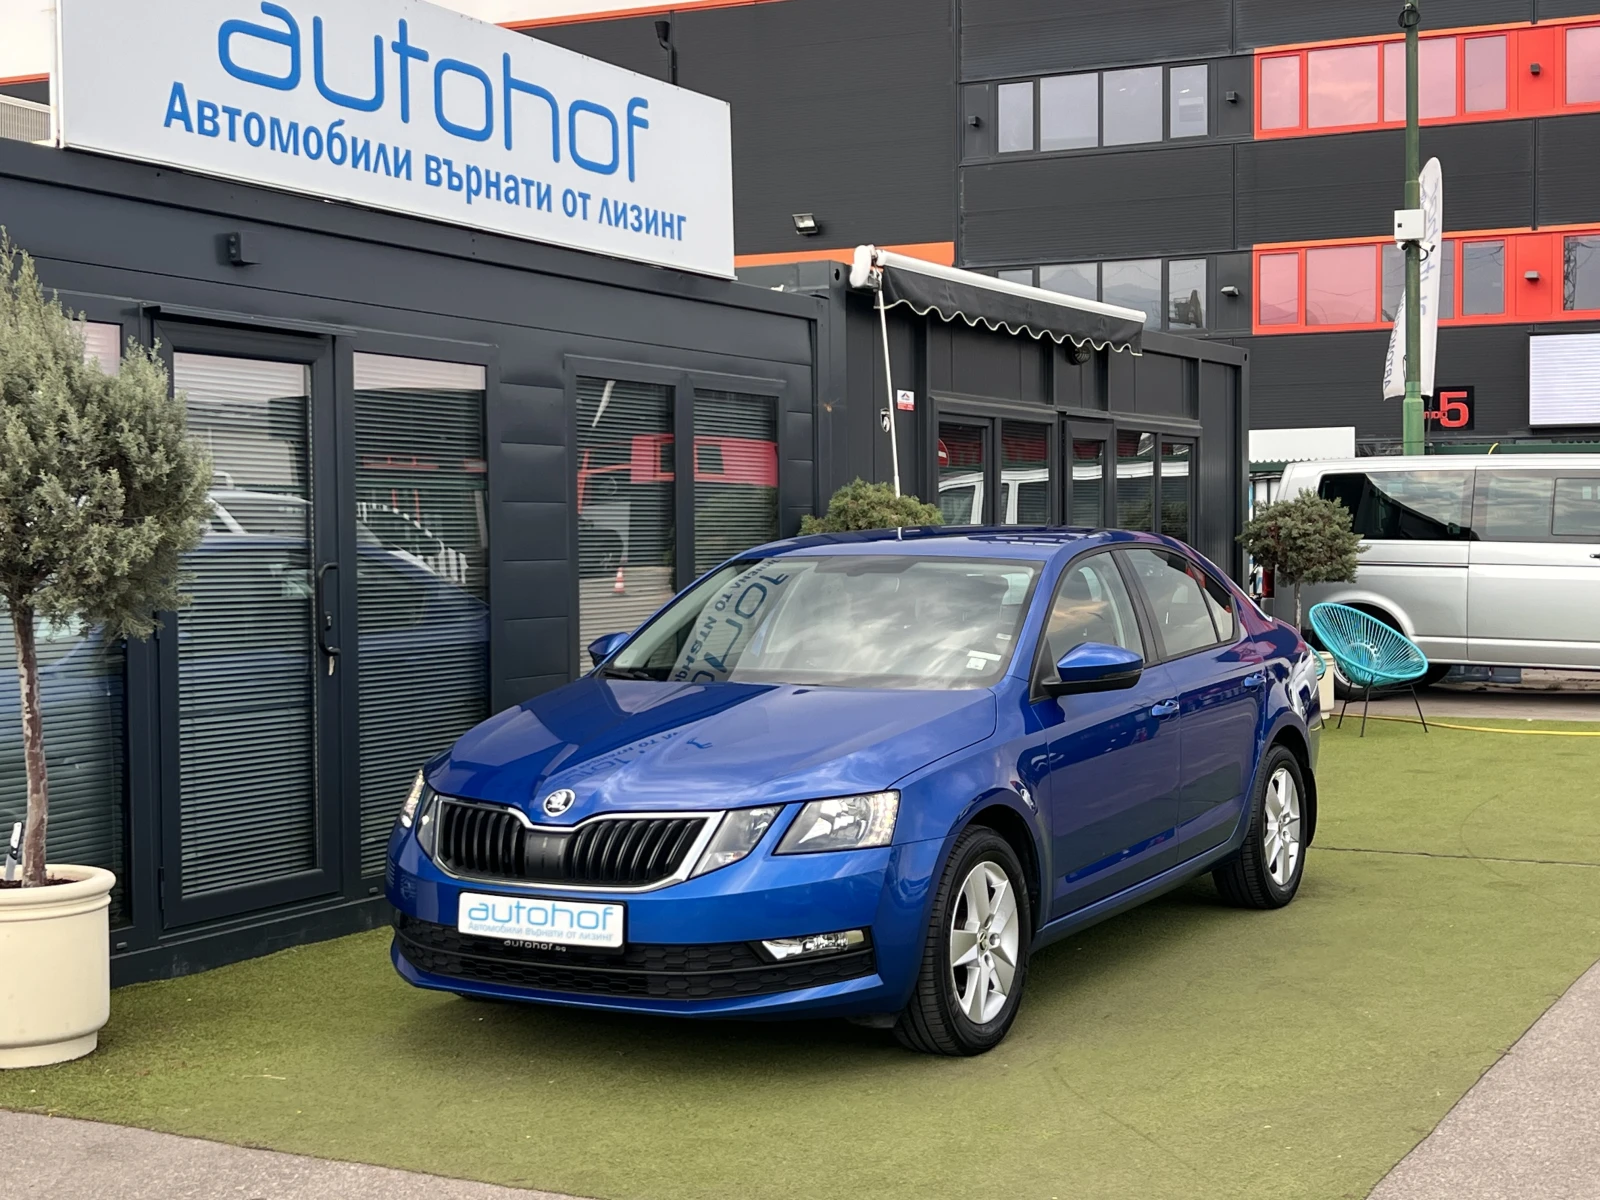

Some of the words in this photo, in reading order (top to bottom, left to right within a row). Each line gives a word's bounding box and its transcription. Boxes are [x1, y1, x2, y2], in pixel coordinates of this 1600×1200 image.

[218, 1, 649, 183] autohof
[163, 80, 412, 181] Автомобили
[425, 153, 553, 213] върнати
[562, 188, 592, 221] от
[599, 197, 687, 241] лизинг
[1440, 391, 1469, 428] 5
[468, 900, 613, 930] autohof
[468, 921, 523, 935] Автомобили
[525, 927, 563, 940] върнати
[566, 931, 577, 939] от
[579, 932, 613, 942] лизинг
